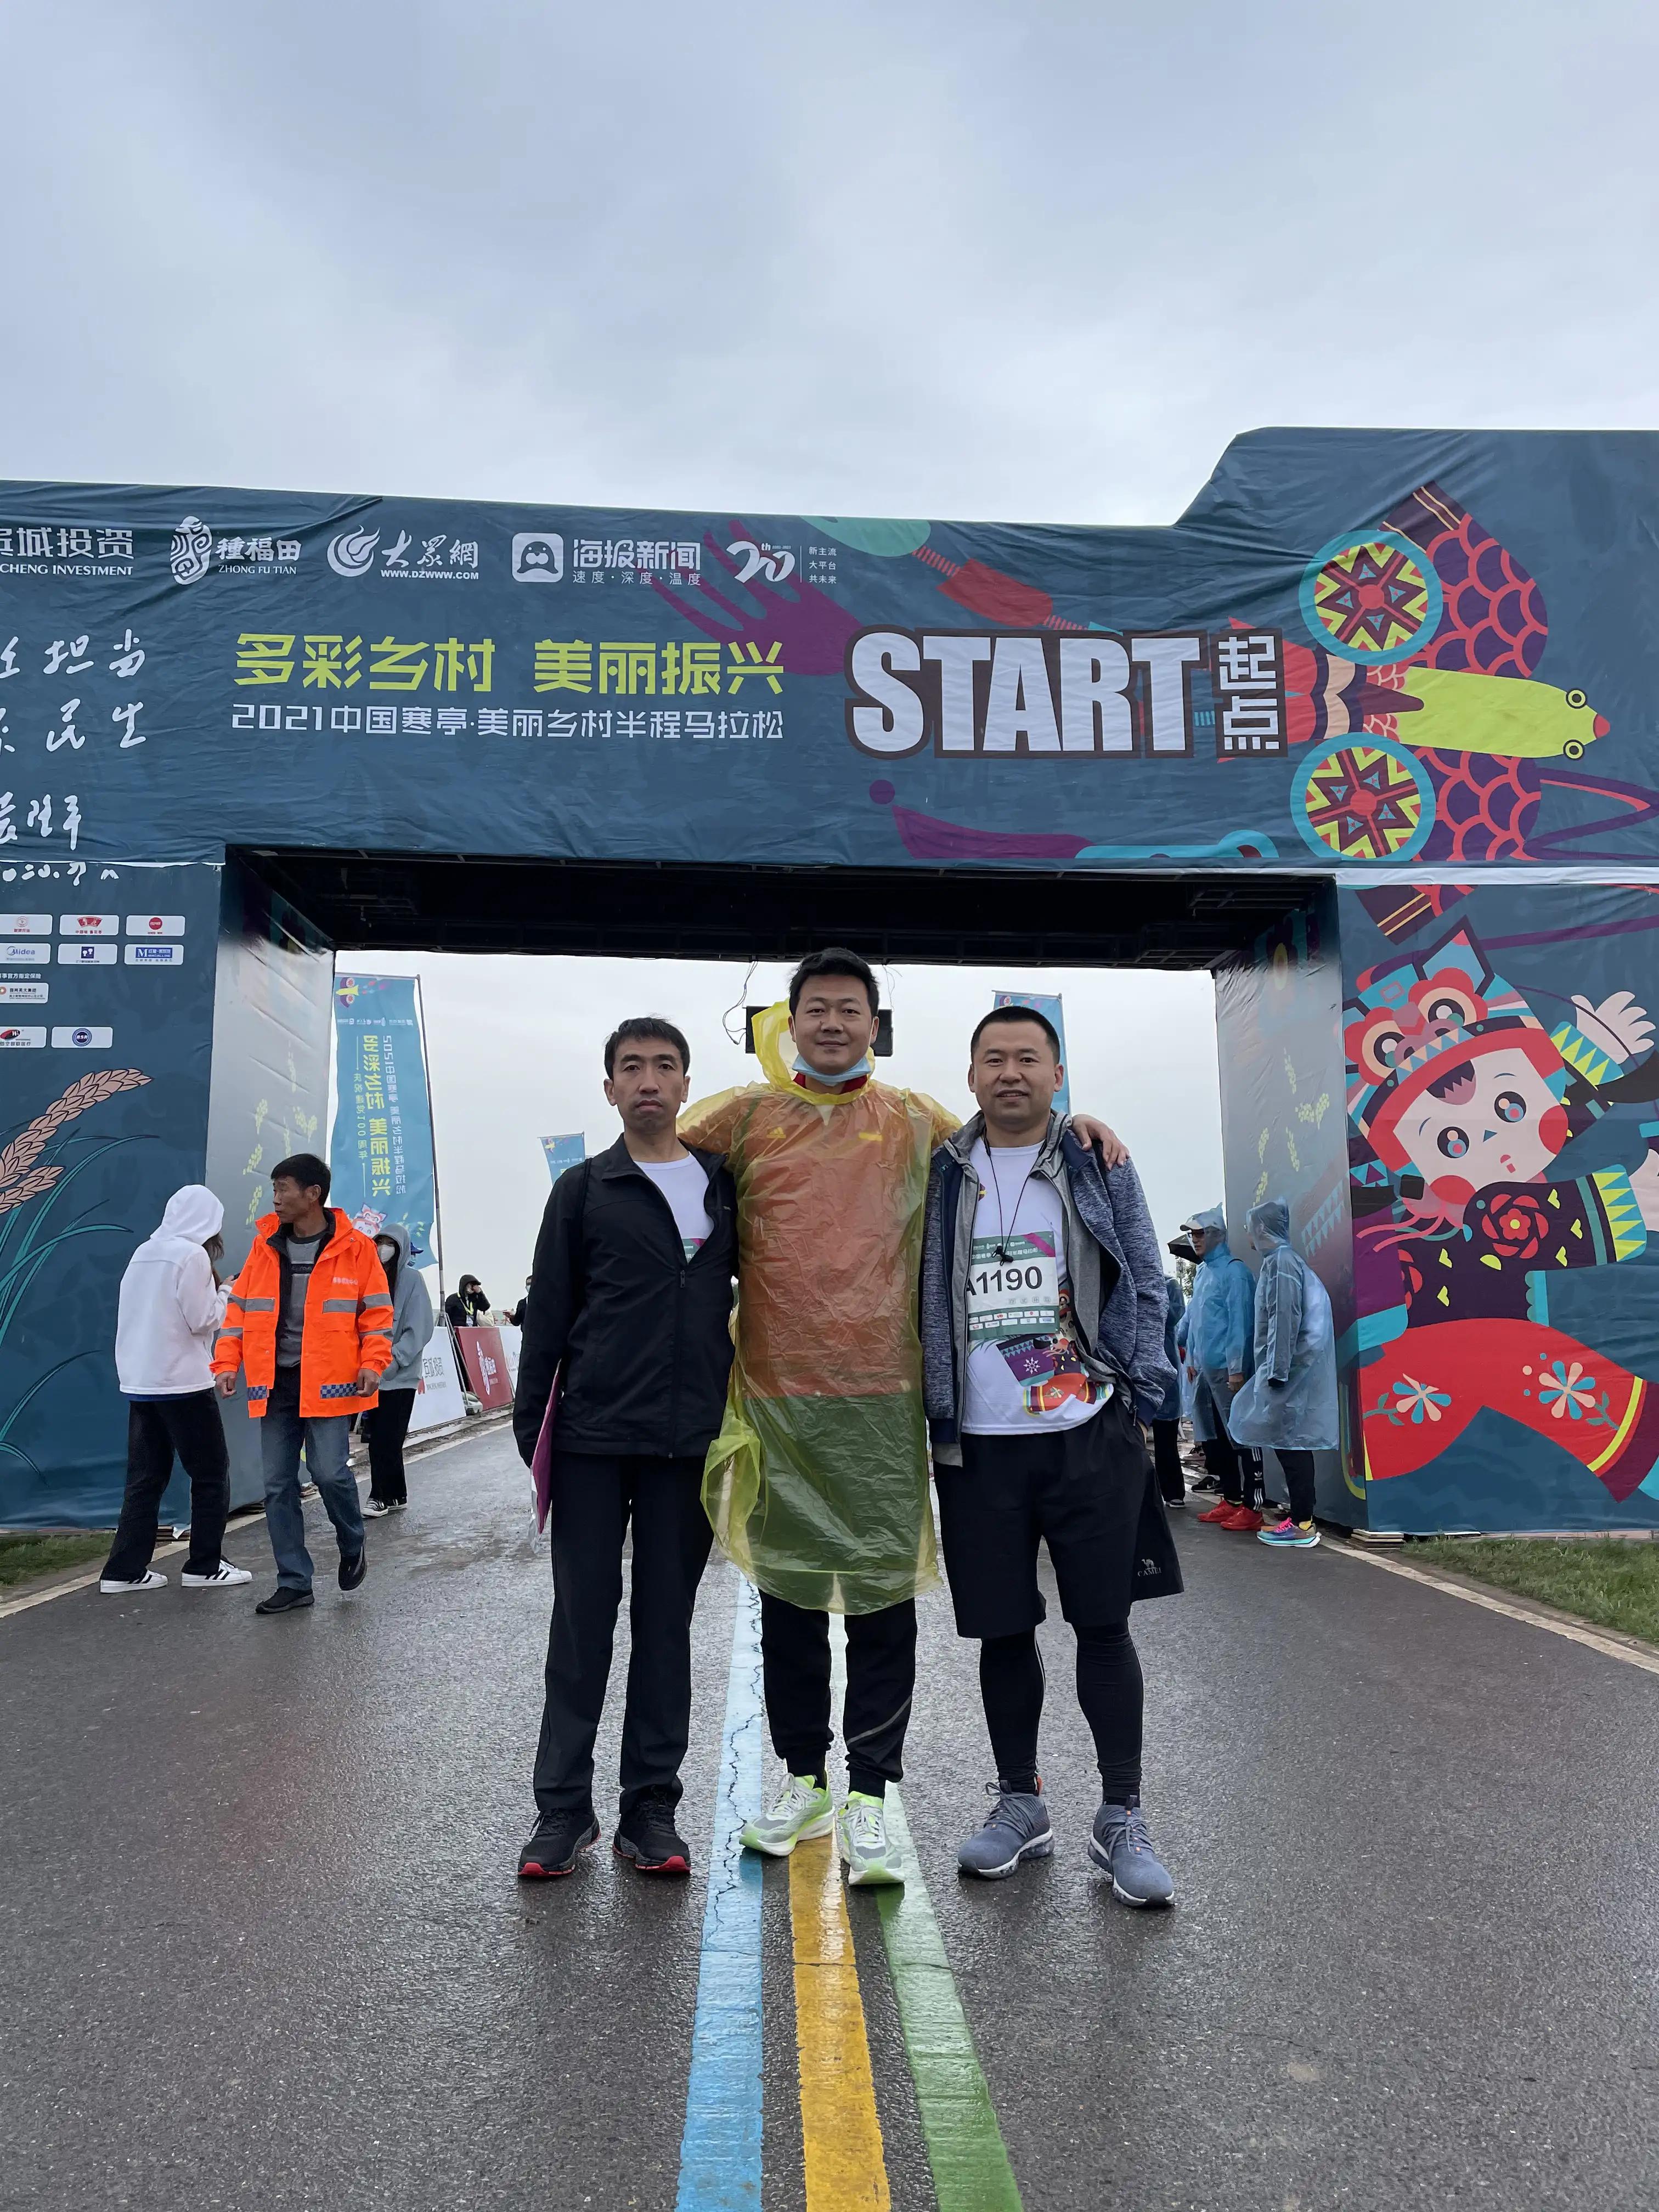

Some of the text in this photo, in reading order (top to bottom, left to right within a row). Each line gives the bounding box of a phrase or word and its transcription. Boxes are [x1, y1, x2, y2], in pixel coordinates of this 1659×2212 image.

[573, 539, 701, 570] 海报新闻
[809, 546, 837, 556] 新主流
[0, 563, 133, 575] CHENG INVESTMENT
[218, 565, 255, 574] ZHONG
[273, 566, 297, 574] TIAN
[809, 561, 837, 571] 大平台
[809, 574, 837, 584] 共未来
[234, 633, 784, 695] 多彩乡村 美丽振兴
[851, 631, 1200, 752] START
[1218, 635, 1280, 751] 起点
